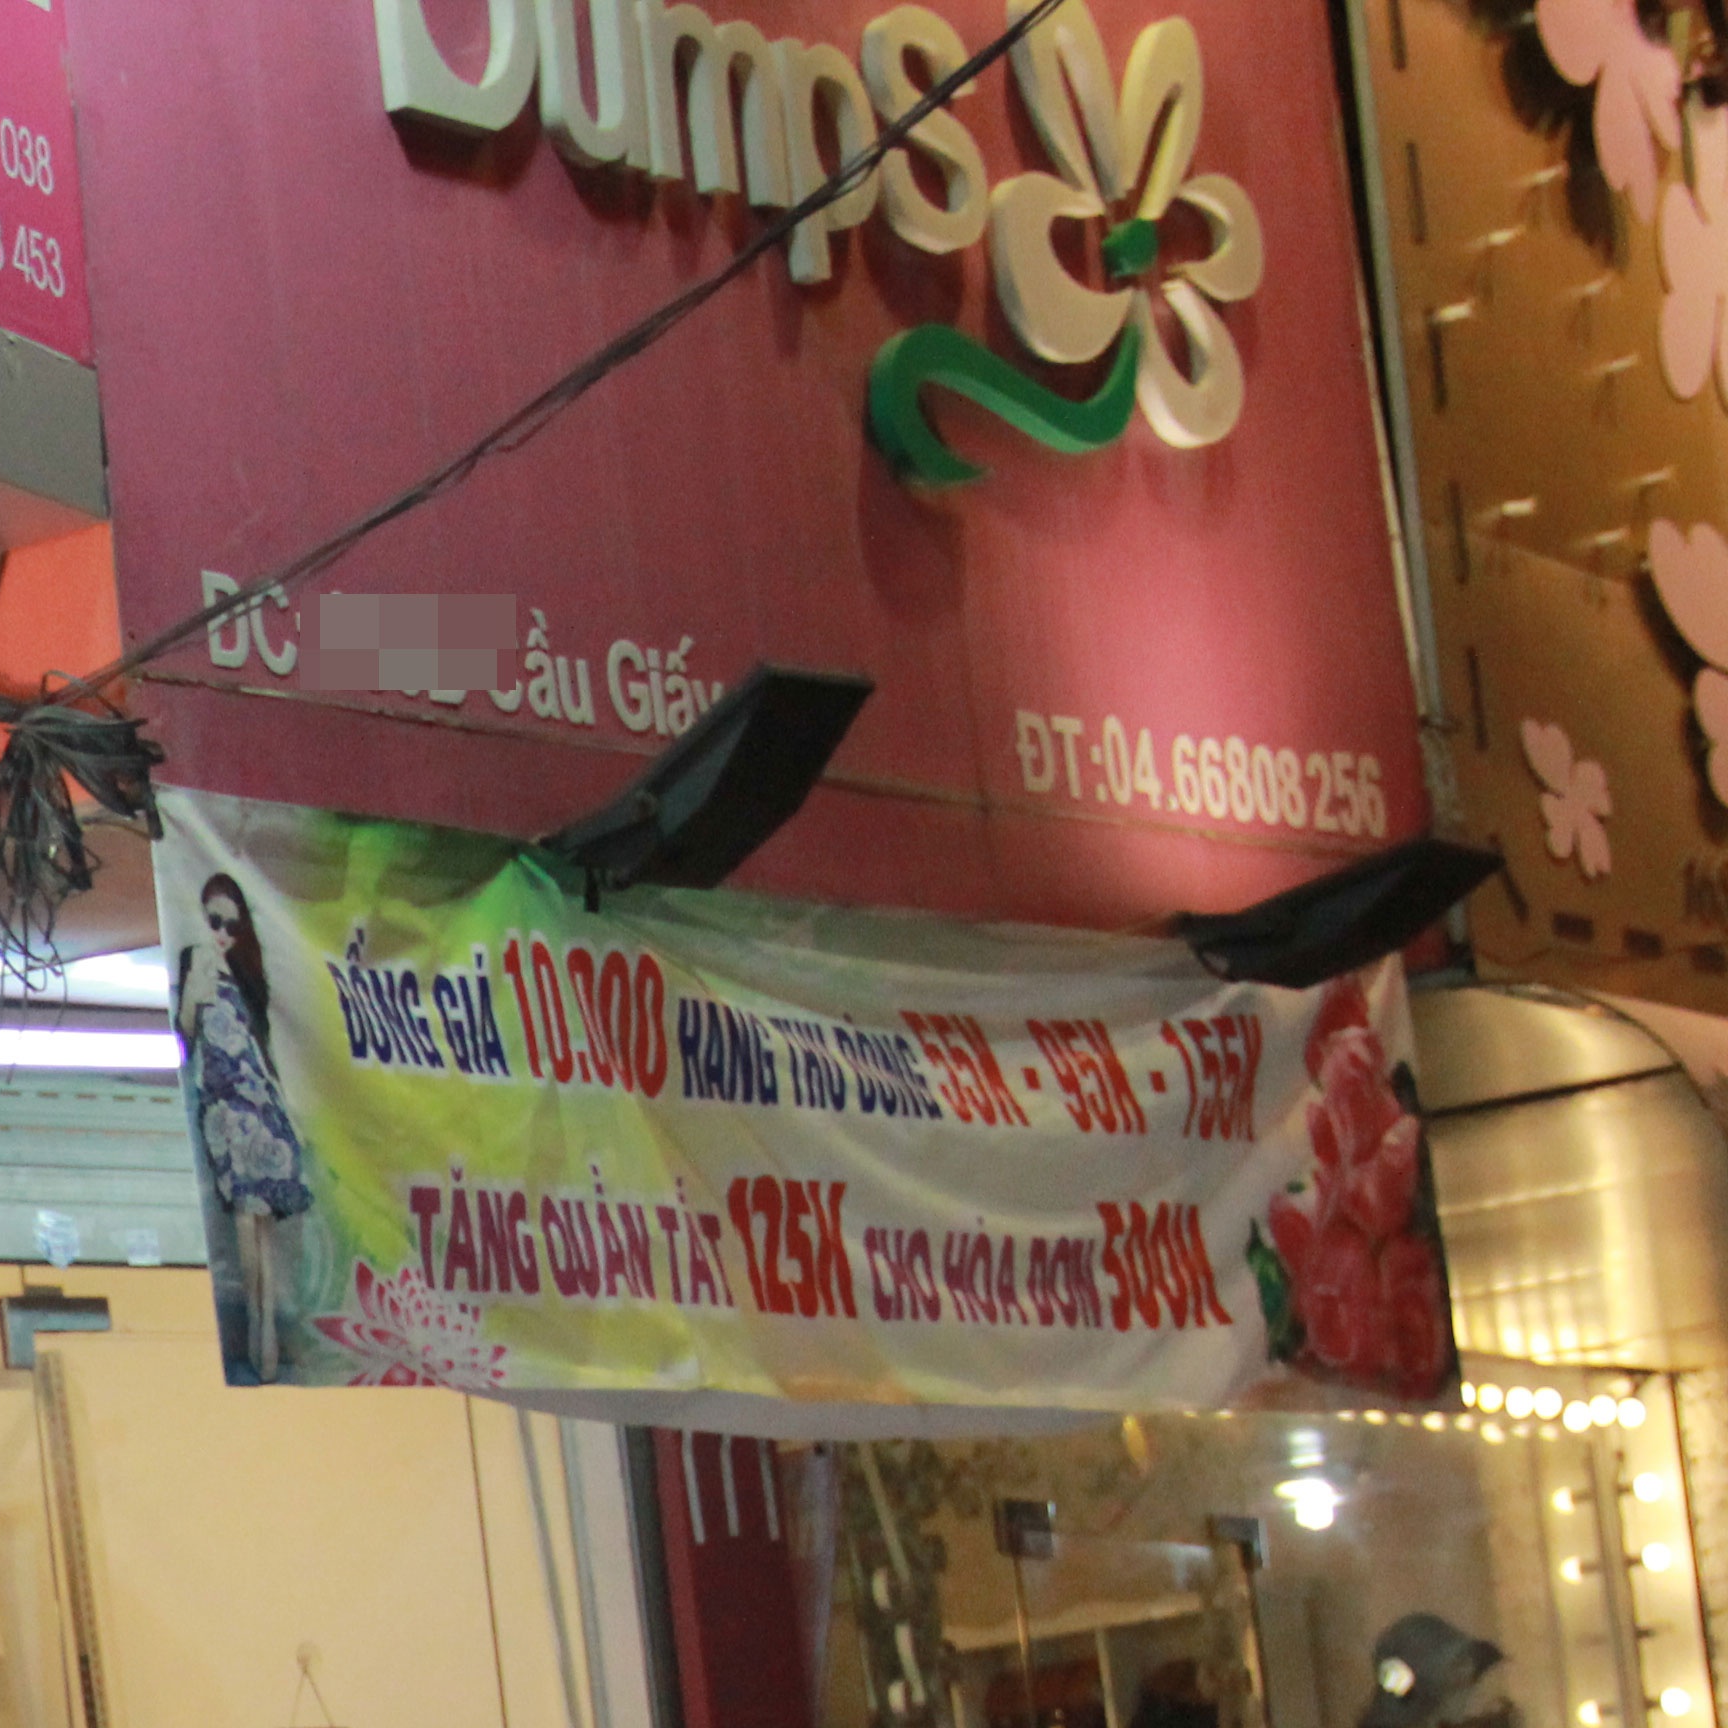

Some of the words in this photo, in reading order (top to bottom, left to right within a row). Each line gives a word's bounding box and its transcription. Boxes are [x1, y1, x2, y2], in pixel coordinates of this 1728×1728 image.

[0, 117, 55, 195] 038
[12, 225, 66, 298] 453
[489, 606, 596, 725] ầu
[432, 952, 511, 1077] GIÁ
[503, 939, 668, 1100] 10.000
[898, 1009, 1032, 1128] 55K
[1025, 1018, 1148, 1135] 95K
[1160, 1013, 1263, 1143] 155K
[727, 1173, 858, 1319] 125K
[863, 1226, 942, 1323] CHO
[1096, 1200, 1234, 1333] 500K
